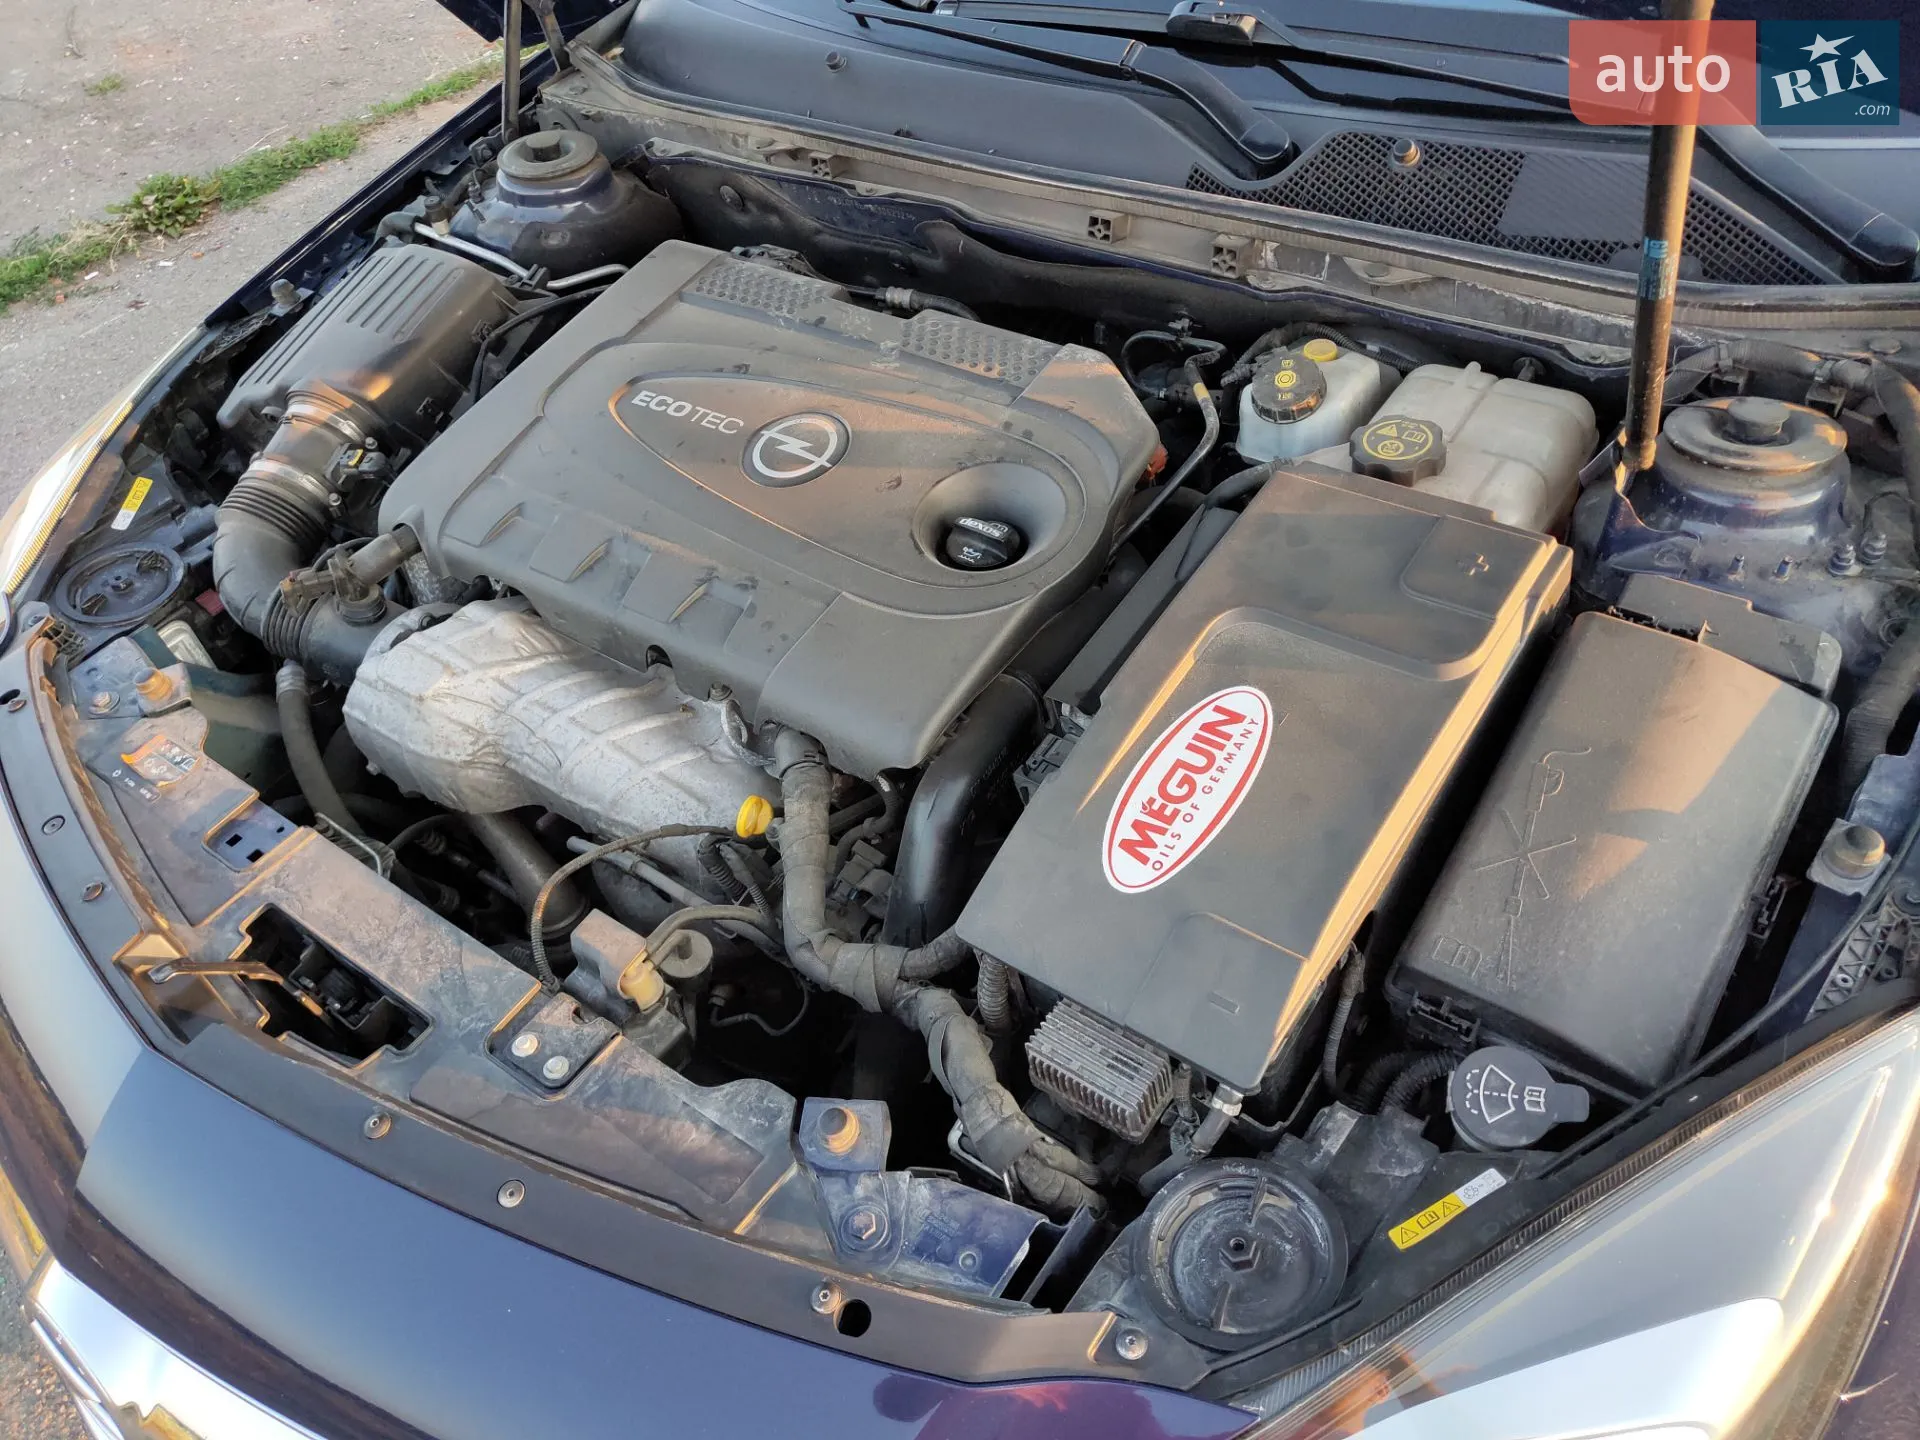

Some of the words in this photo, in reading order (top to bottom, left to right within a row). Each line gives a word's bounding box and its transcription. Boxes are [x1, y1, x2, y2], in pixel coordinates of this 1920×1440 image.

[631, 389, 745, 434] ECOTEC
[958, 517, 1004, 538] dexos
[1151, 832, 1182, 871] OILS
[1182, 802, 1201, 823] OF
[1201, 717, 1260, 795] GERMANY
